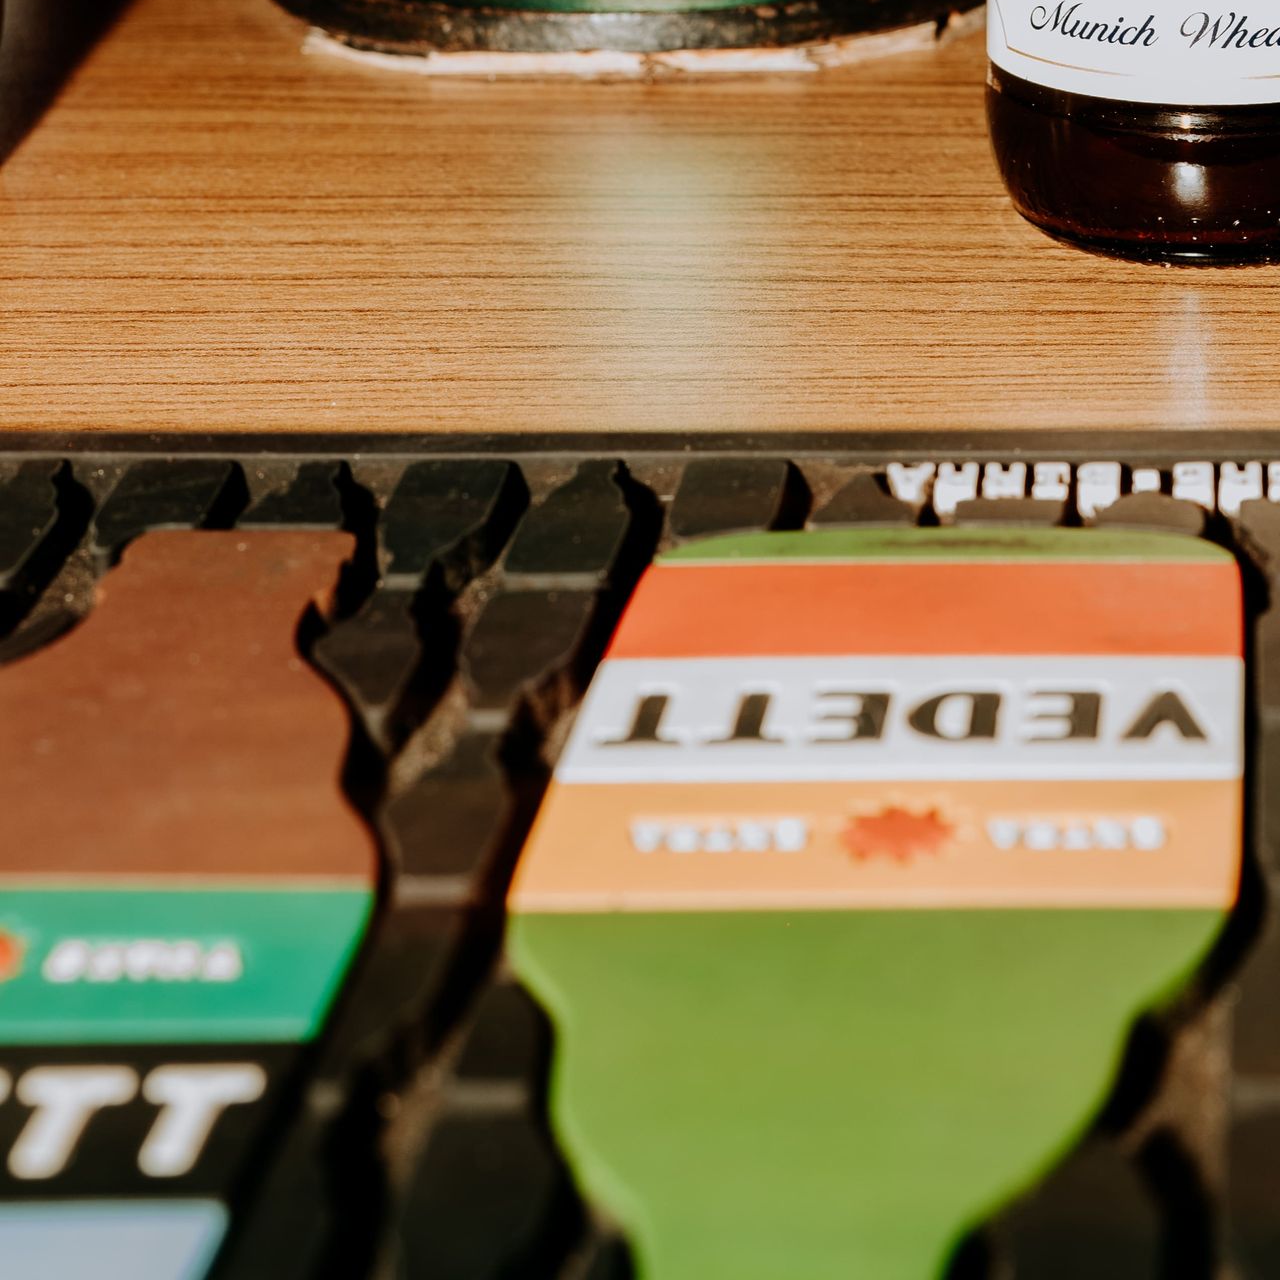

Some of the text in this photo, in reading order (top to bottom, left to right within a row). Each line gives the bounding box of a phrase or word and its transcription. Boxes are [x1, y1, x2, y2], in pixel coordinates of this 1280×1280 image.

[1030, 0, 1158, 48] Munich
[887, 461, 1121, 519] BIRRA
[590, 690, 1210, 746] VEDETT
[0, 1064, 266, 1180] TT
